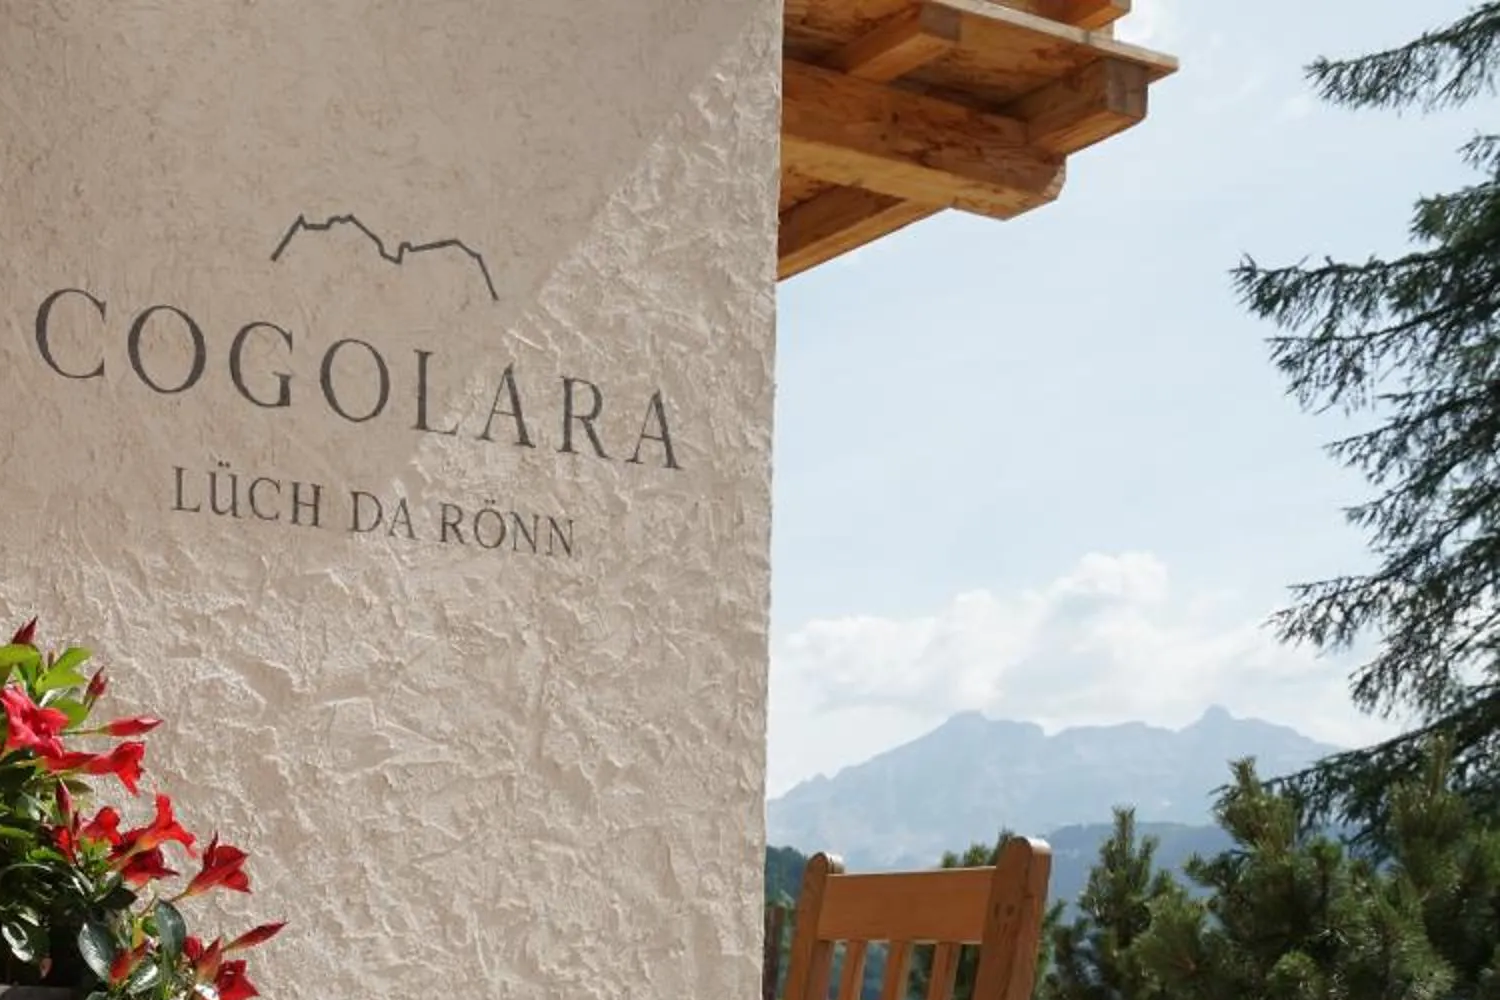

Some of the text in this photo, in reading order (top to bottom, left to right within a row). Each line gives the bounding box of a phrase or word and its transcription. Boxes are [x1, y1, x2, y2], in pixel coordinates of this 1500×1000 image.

[35, 288, 684, 471] COGOLARA
[172, 461, 576, 558] LÜCH DA RÖNN
